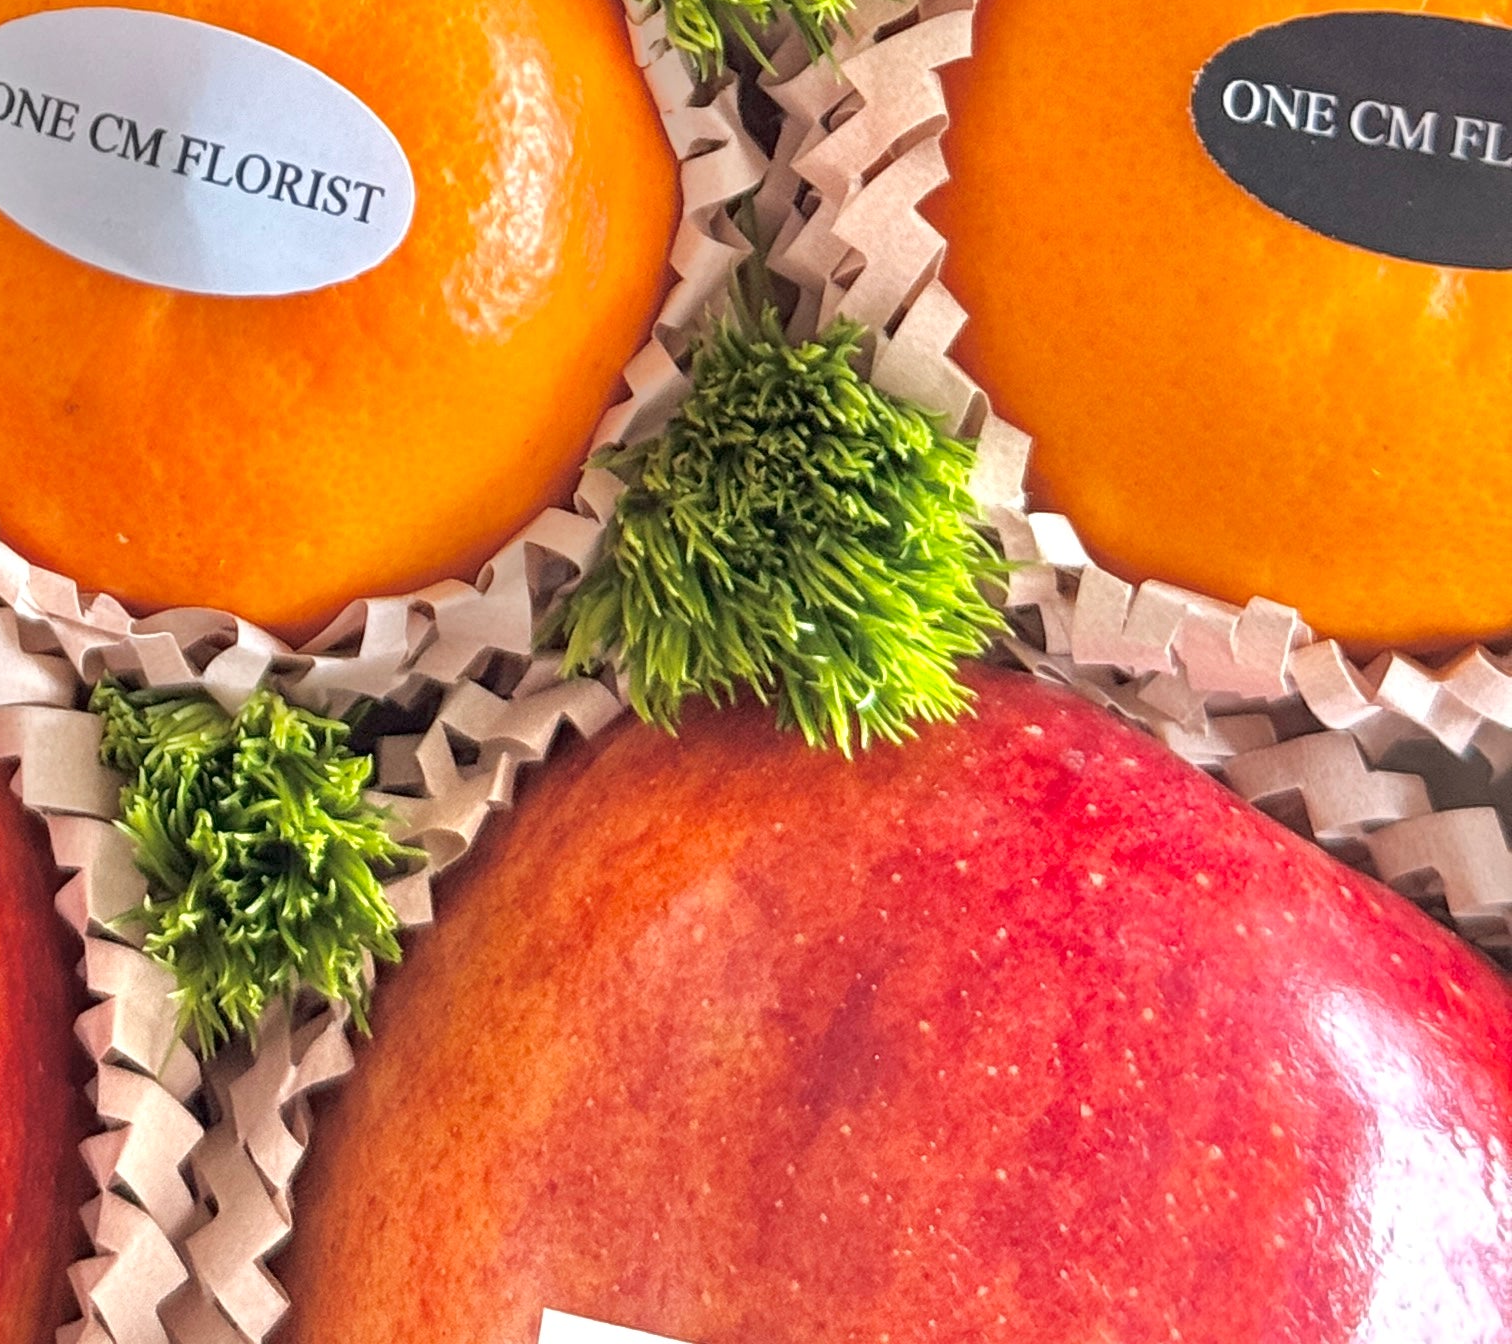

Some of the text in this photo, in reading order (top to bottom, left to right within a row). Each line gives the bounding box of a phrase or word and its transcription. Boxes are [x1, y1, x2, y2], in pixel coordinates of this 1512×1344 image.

[1222, 79, 1338, 138] ONE
[1350, 100, 1439, 155] CM
[88, 112, 167, 169] CM
[173, 134, 385, 225] FLORIST
